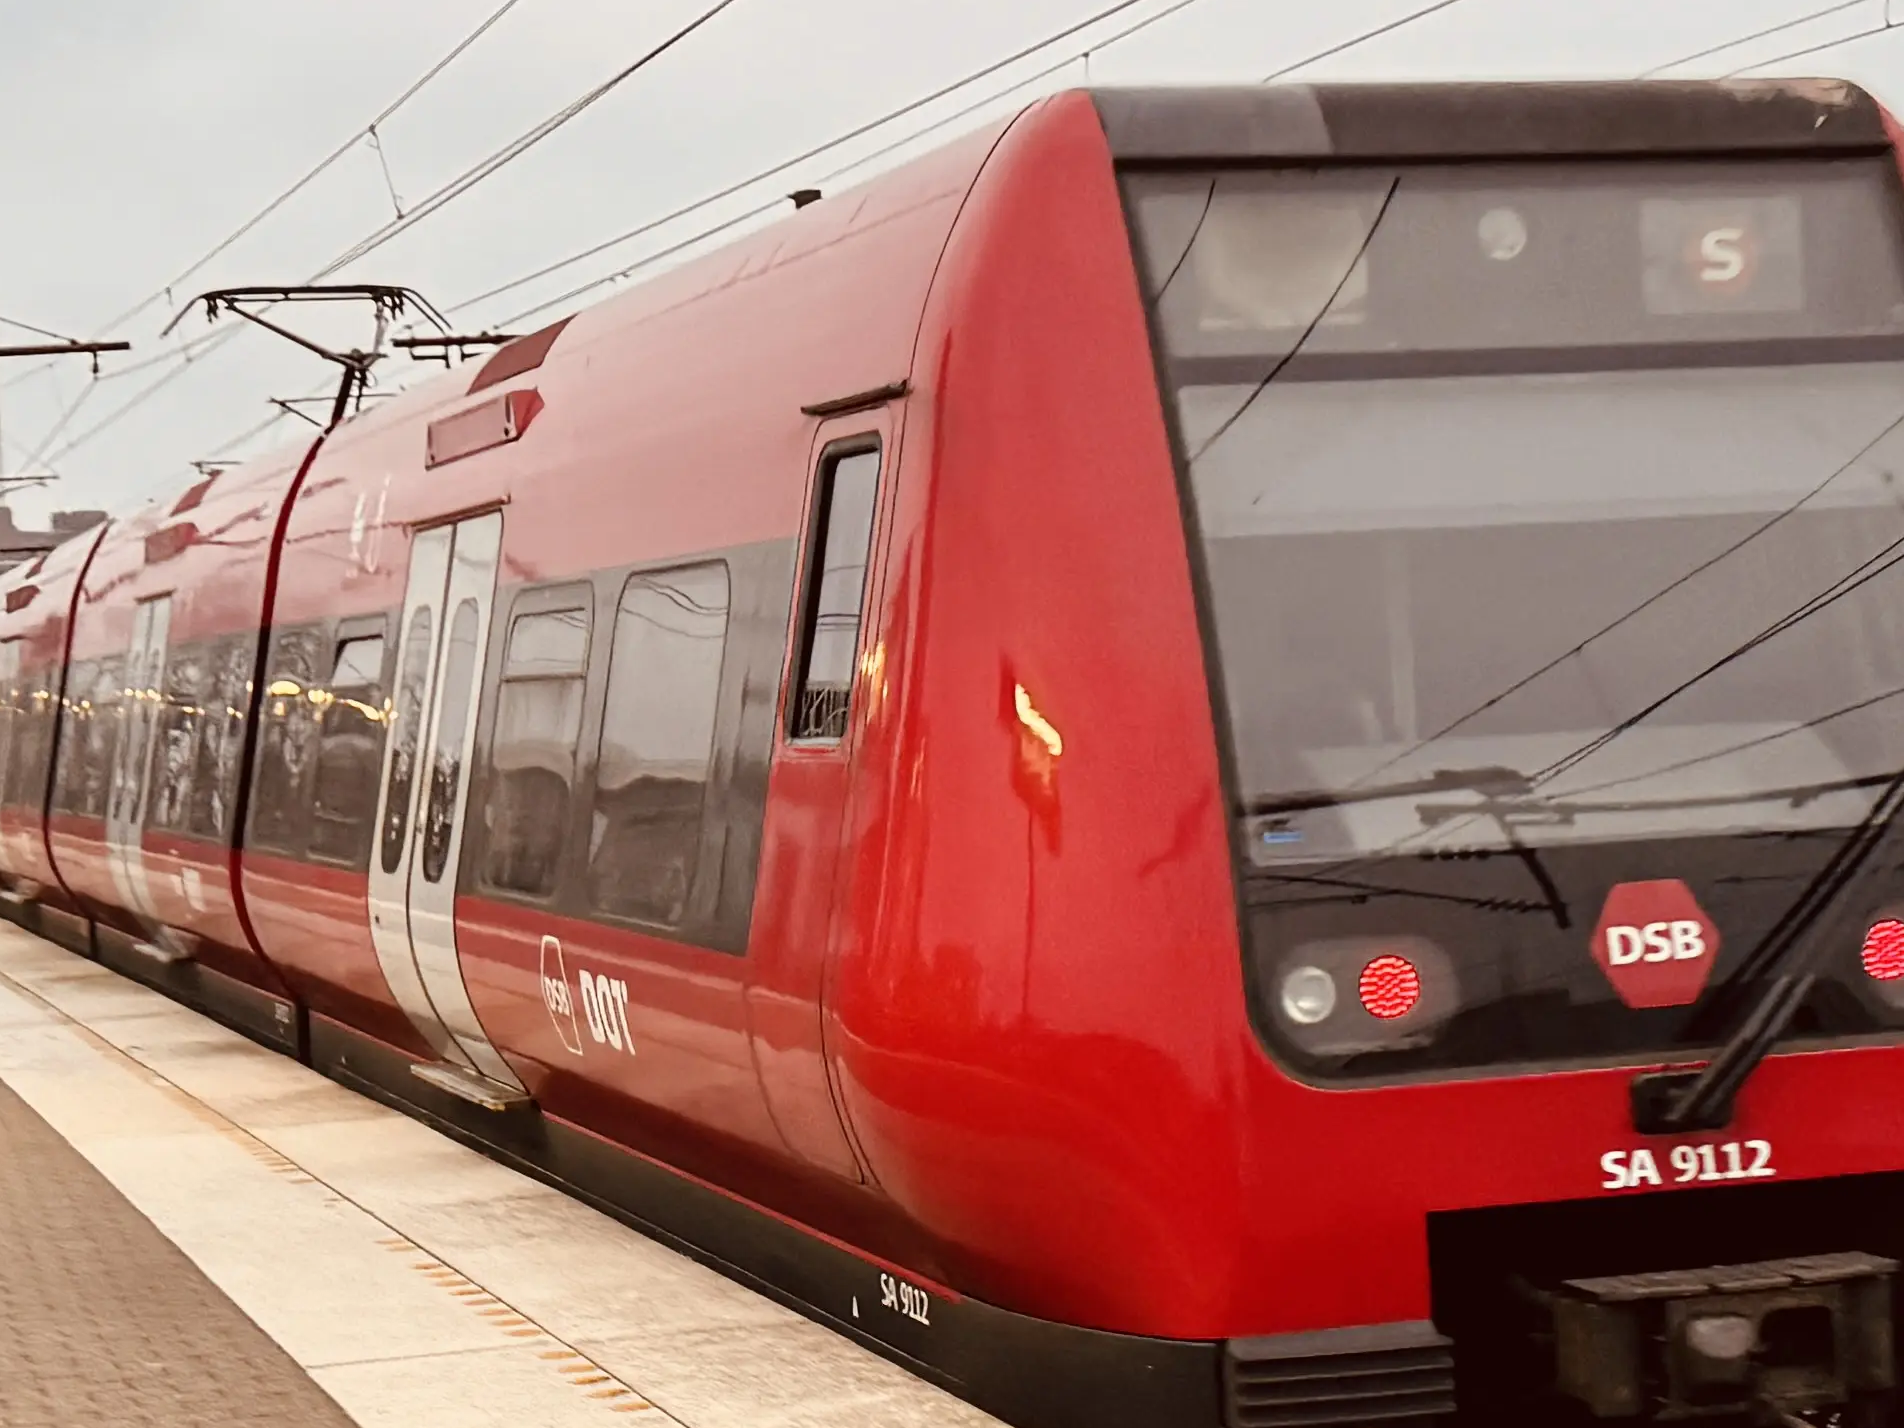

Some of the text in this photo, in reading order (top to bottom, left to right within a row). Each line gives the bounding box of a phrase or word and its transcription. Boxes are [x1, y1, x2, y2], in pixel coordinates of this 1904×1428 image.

[1700, 228, 1744, 281] S
[1606, 920, 1706, 965] DSB
[543, 976, 571, 1016] DSB
[579, 969, 636, 1055] DOT
[1600, 1140, 1776, 1189] SA 9112
[880, 1273, 929, 1325] SA 9112
